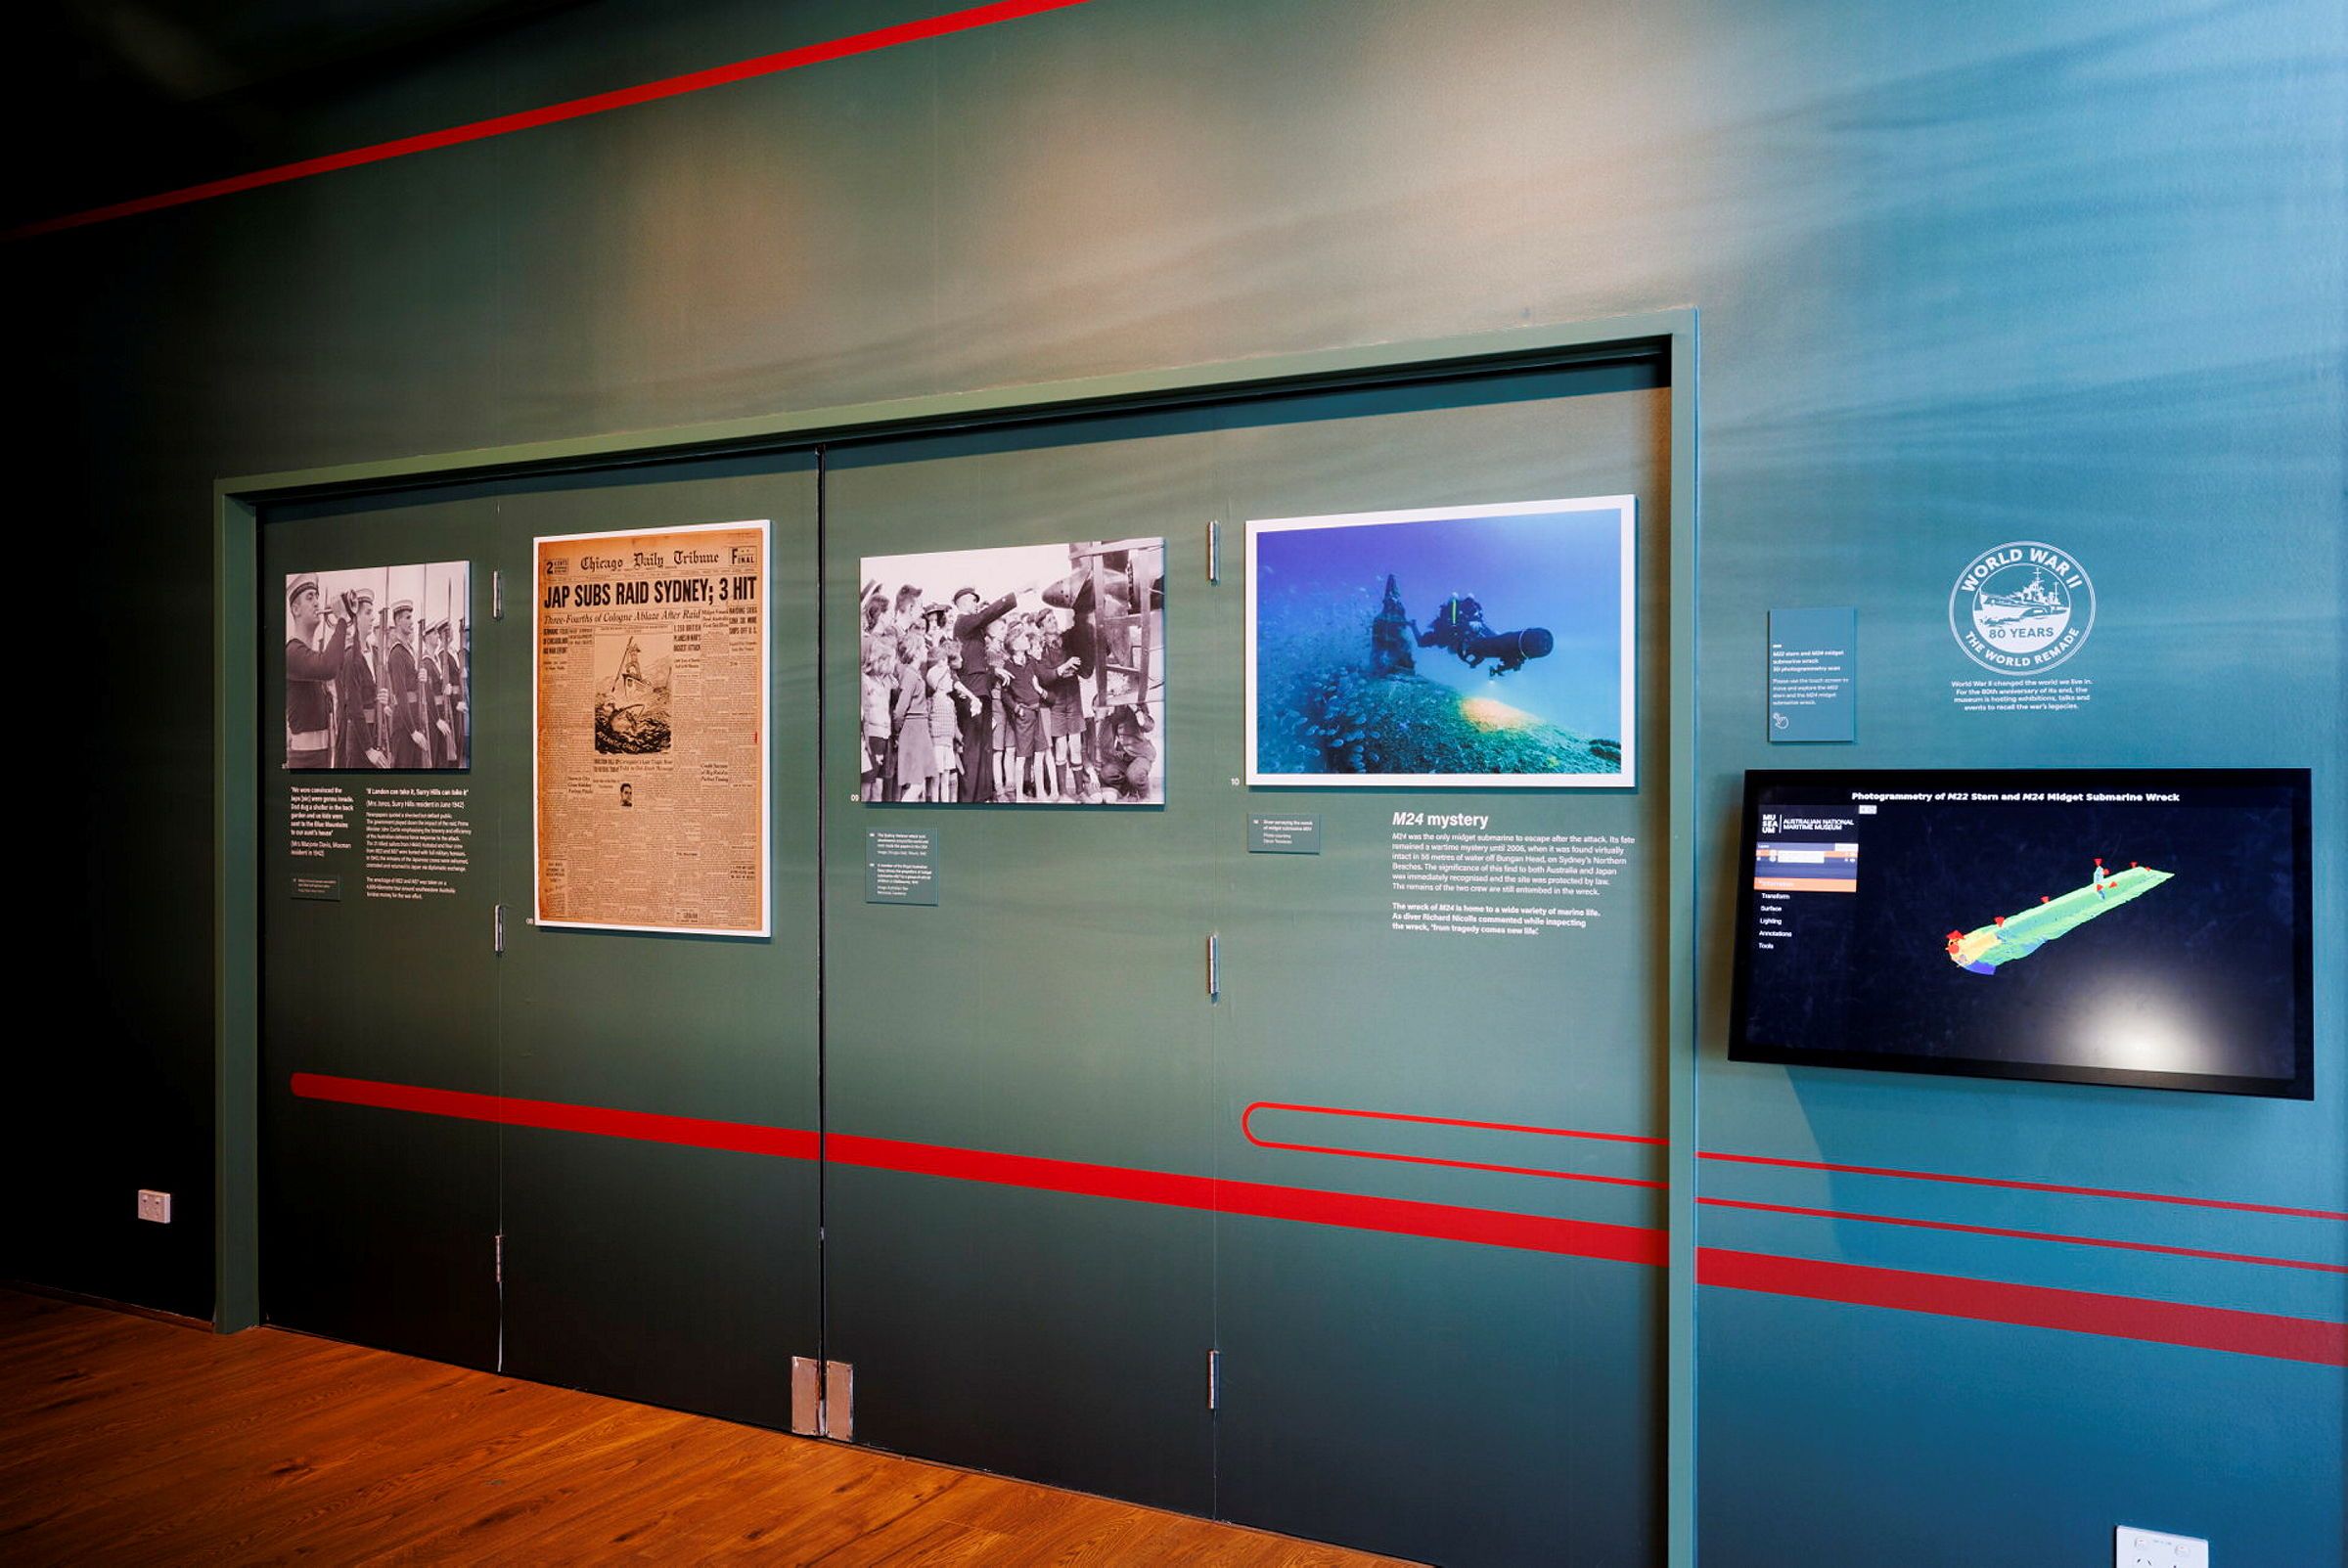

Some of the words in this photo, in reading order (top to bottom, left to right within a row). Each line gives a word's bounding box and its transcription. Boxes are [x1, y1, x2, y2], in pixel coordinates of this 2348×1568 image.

[580, 556, 623, 572] Chicago
[633, 552, 664, 568] Daily
[674, 550, 719, 564] Tribune
[546, 562, 553, 574] 2
[1962, 549, 2023, 593] WORLD
[2030, 548, 2070, 577] WAR
[2066, 574, 2082, 589] II
[544, 585, 570, 608] JAP
[574, 583, 611, 607] SUBS
[616, 582, 649, 605] RAID
[654, 577, 713, 605] SYDNEY;
[719, 577, 728, 600] 3
[733, 576, 757, 600] HIT
[544, 614, 593, 625] Three-Fourths
[594, 614, 602, 623] of
[604, 613, 631, 623] Cologne
[633, 612, 660, 621] Ablaze
[661, 611, 680, 619] After
[682, 609, 701, 618] Raid
[1989, 629, 2006, 639] 80
[2010, 627, 2054, 638] YEARS
[1965, 631, 1985, 653] THE
[1985, 649, 2031, 667] WORLD
[2034, 627, 2080, 665] REMADE
[1231, 777, 1240, 786] 10
[1852, 792, 1932, 802] Photogrammetry
[2047, 793, 2083, 802] Midget
[2086, 793, 2143, 801] Submarine
[2146, 793, 2180, 801] Wreck
[1392, 812, 1424, 825] M24
[1428, 813, 1489, 829] mystery
[1571, 846, 1593, 854] found
[1424, 863, 1437, 871] The
[1443, 883, 1454, 891] the
[1562, 887, 1574, 895] the
[1392, 902, 1406, 910] The
[1392, 912, 1402, 920] As
[1523, 916, 1544, 925] while
[1392, 922, 1404, 930] the
